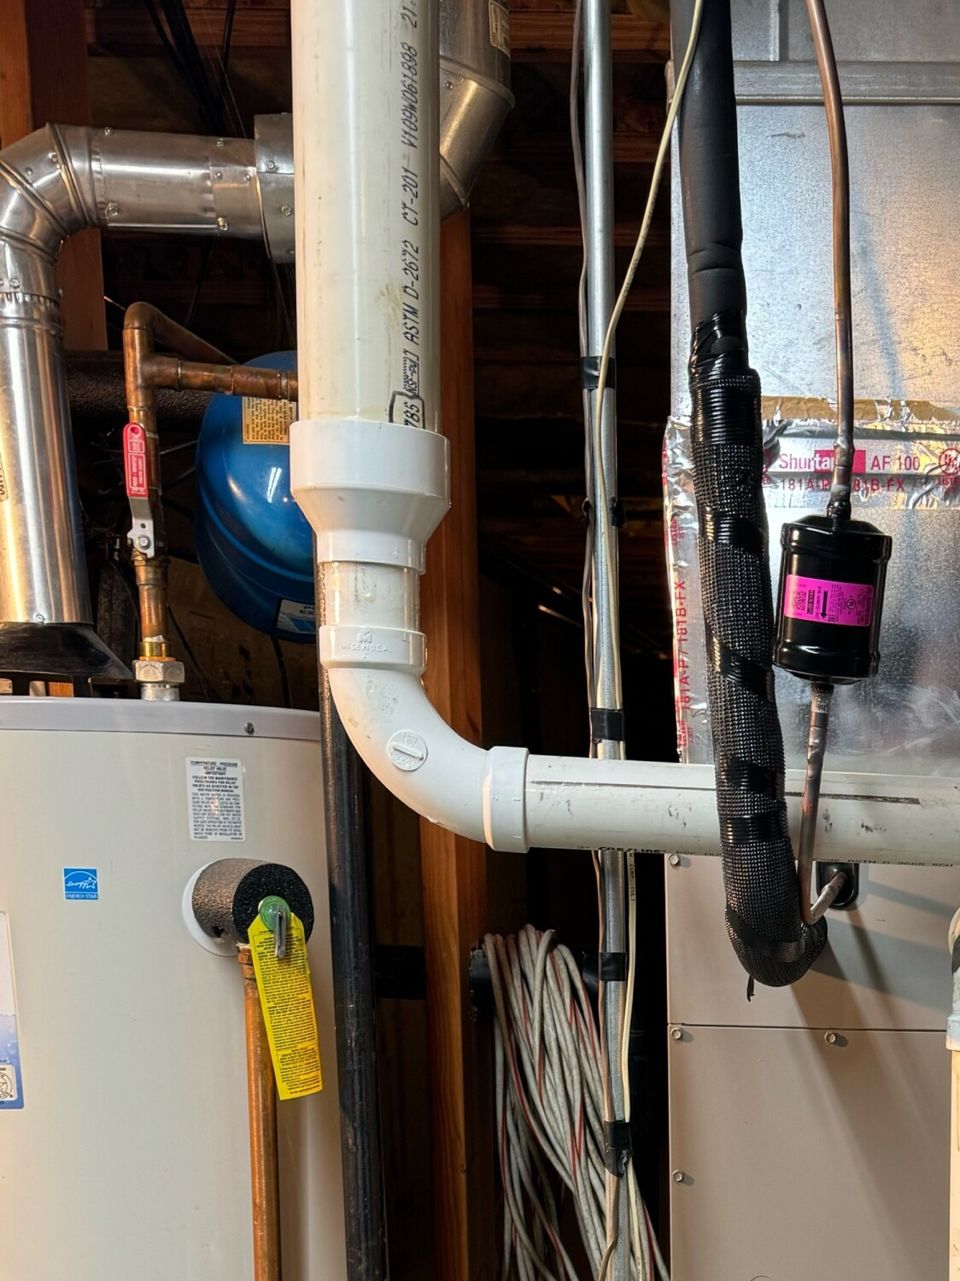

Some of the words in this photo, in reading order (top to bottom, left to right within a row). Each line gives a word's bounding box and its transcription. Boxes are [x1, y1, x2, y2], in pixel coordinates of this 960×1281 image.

[401, 168, 418, 226] CT-201
[402, 240, 419, 300] D-2672
[402, 304, 419, 345] ASTM
[871, 455, 890, 471] AF
[896, 454, 920, 471] 100
[853, 479, 904, 492] 81B-FX
